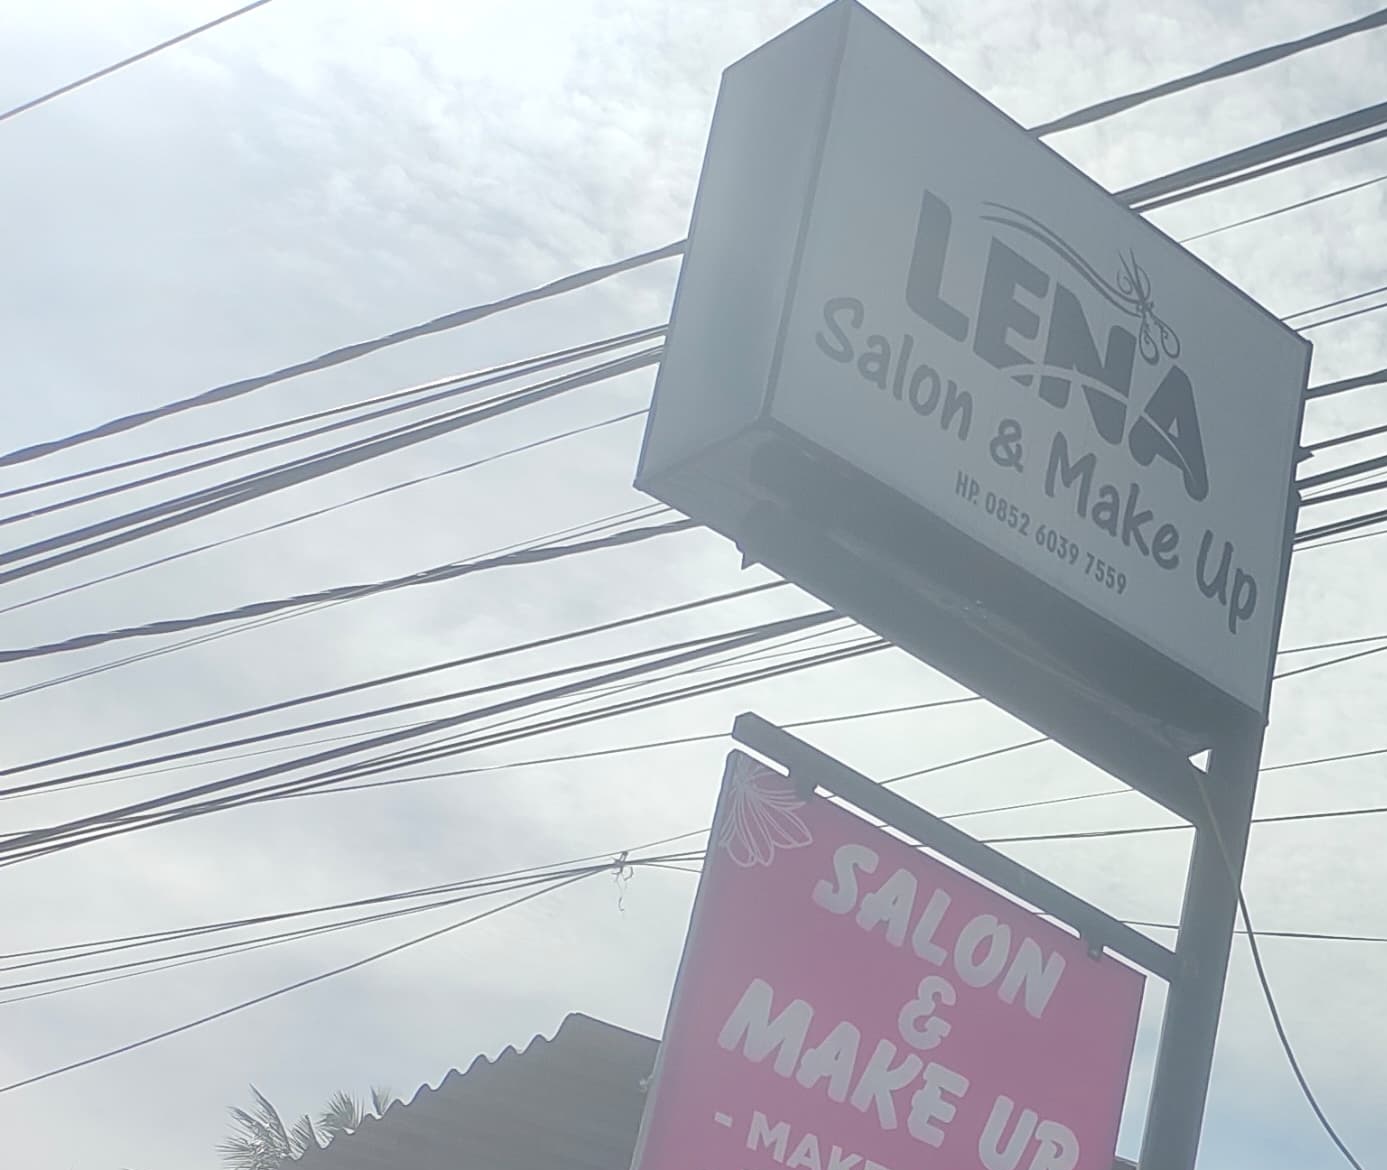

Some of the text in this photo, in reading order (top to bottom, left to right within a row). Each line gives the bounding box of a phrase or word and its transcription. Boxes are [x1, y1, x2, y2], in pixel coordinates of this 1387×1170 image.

[905, 188, 1209, 502] LENA
[815, 296, 1258, 635] Salon & Make Up
[985, 499, 1031, 537] 0852
[1035, 523, 1081, 567] 6039
[1085, 550, 1128, 596] 7559
[811, 843, 1067, 1020] SALON
[897, 974, 957, 1051] &
[716, 976, 970, 1149] MAKE
